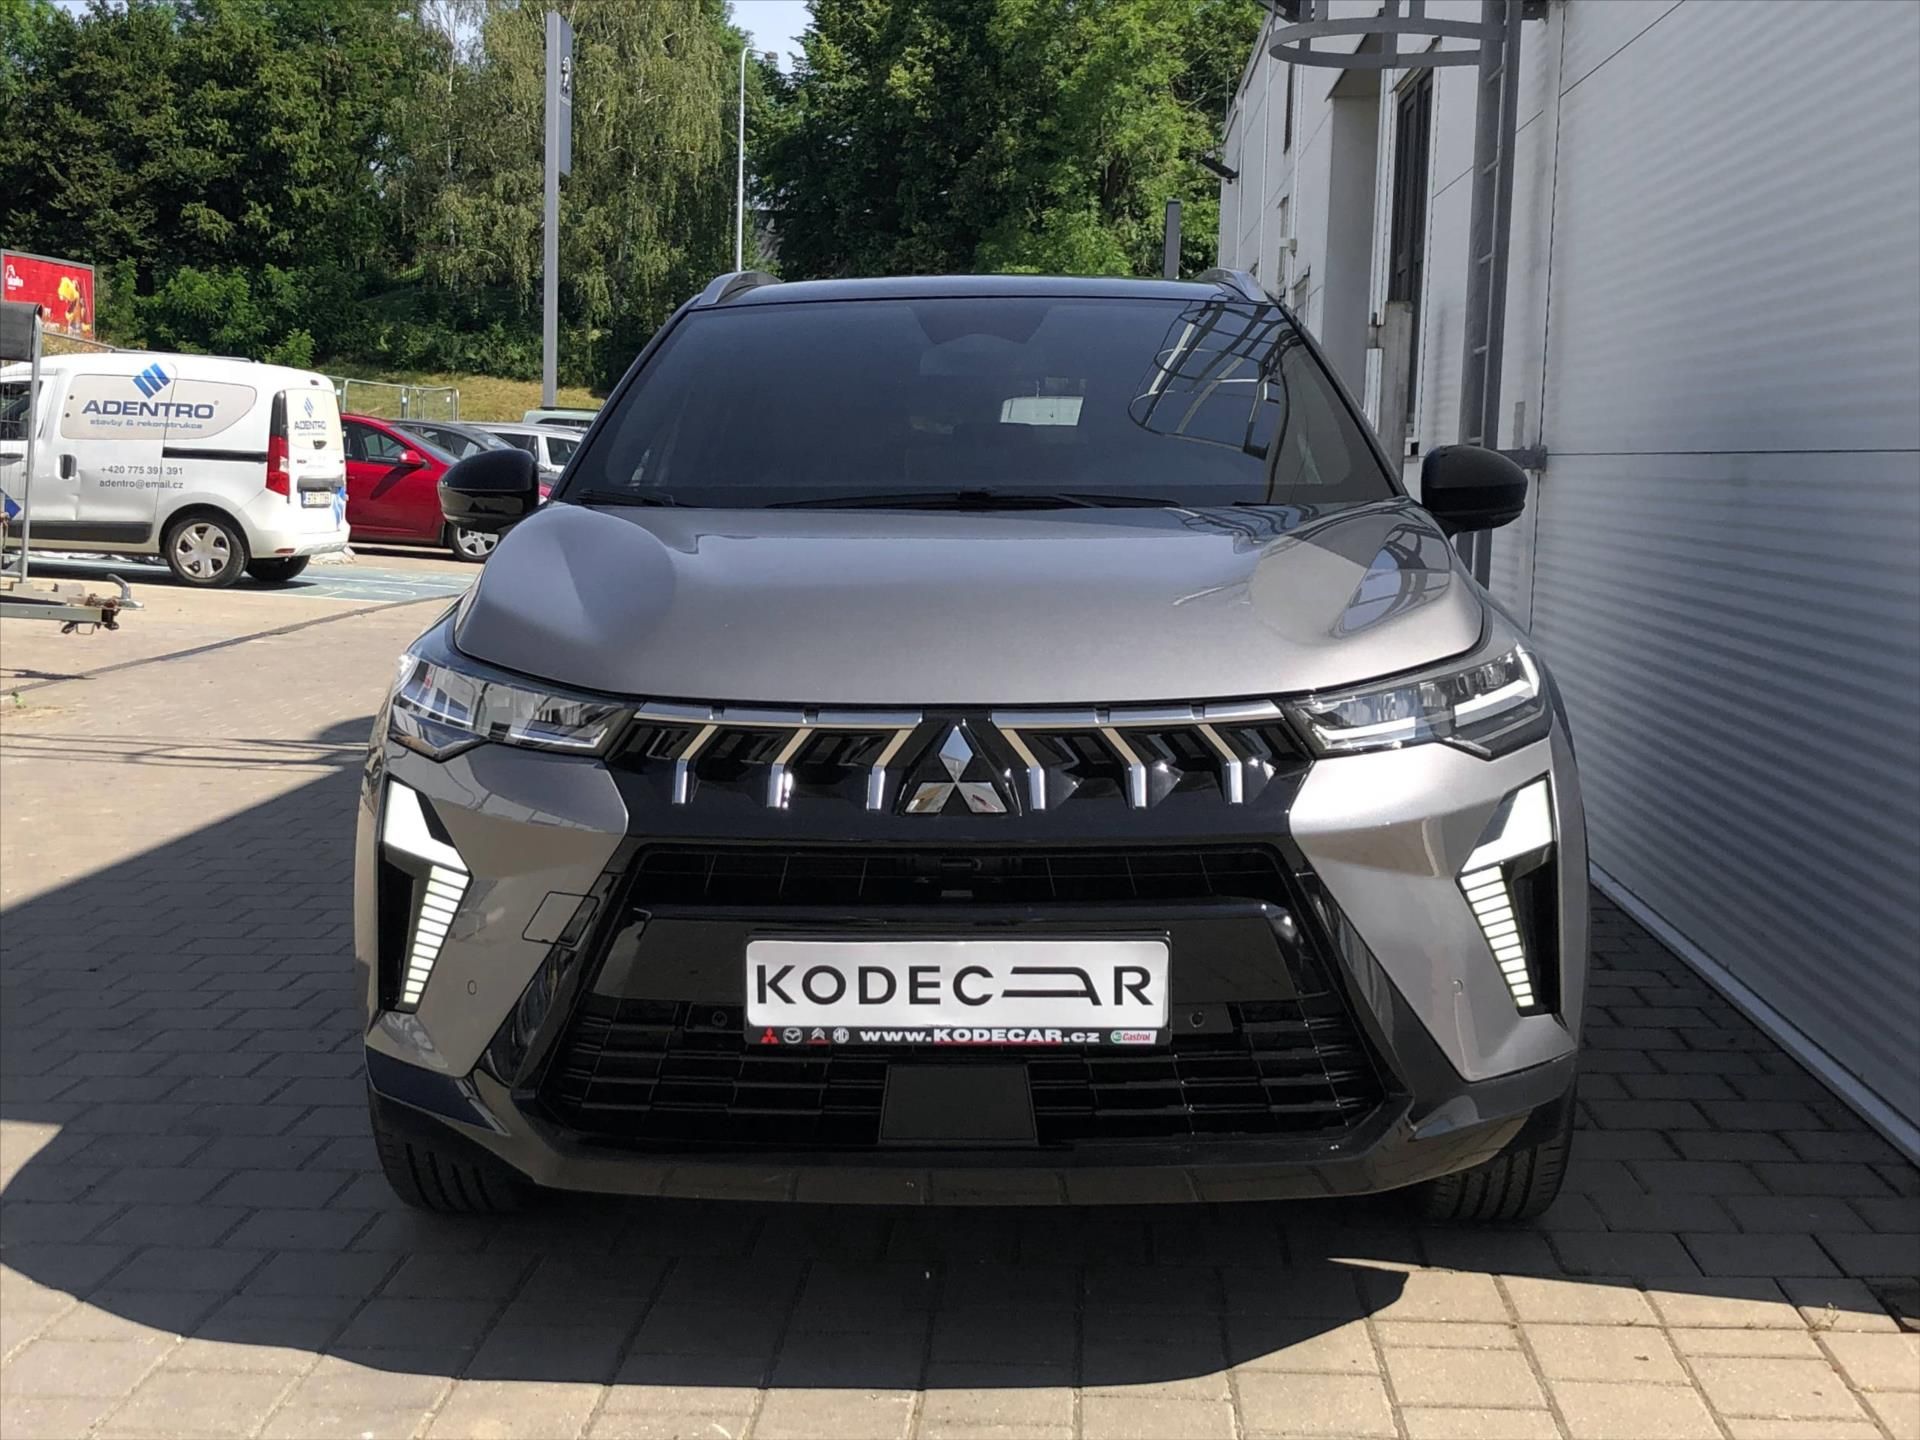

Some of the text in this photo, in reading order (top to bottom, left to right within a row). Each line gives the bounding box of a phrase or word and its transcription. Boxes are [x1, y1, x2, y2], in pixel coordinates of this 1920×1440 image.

[82, 400, 214, 420] ADENTRO
[101, 465, 183, 476] +420 775 391 391
[99, 479, 184, 489] adentro@email.cz
[756, 965, 1154, 1006] KODECAR
[859, 1028, 1100, 1043] www.KODECAR.cz
[1122, 1031, 1151, 1041] Castrol
